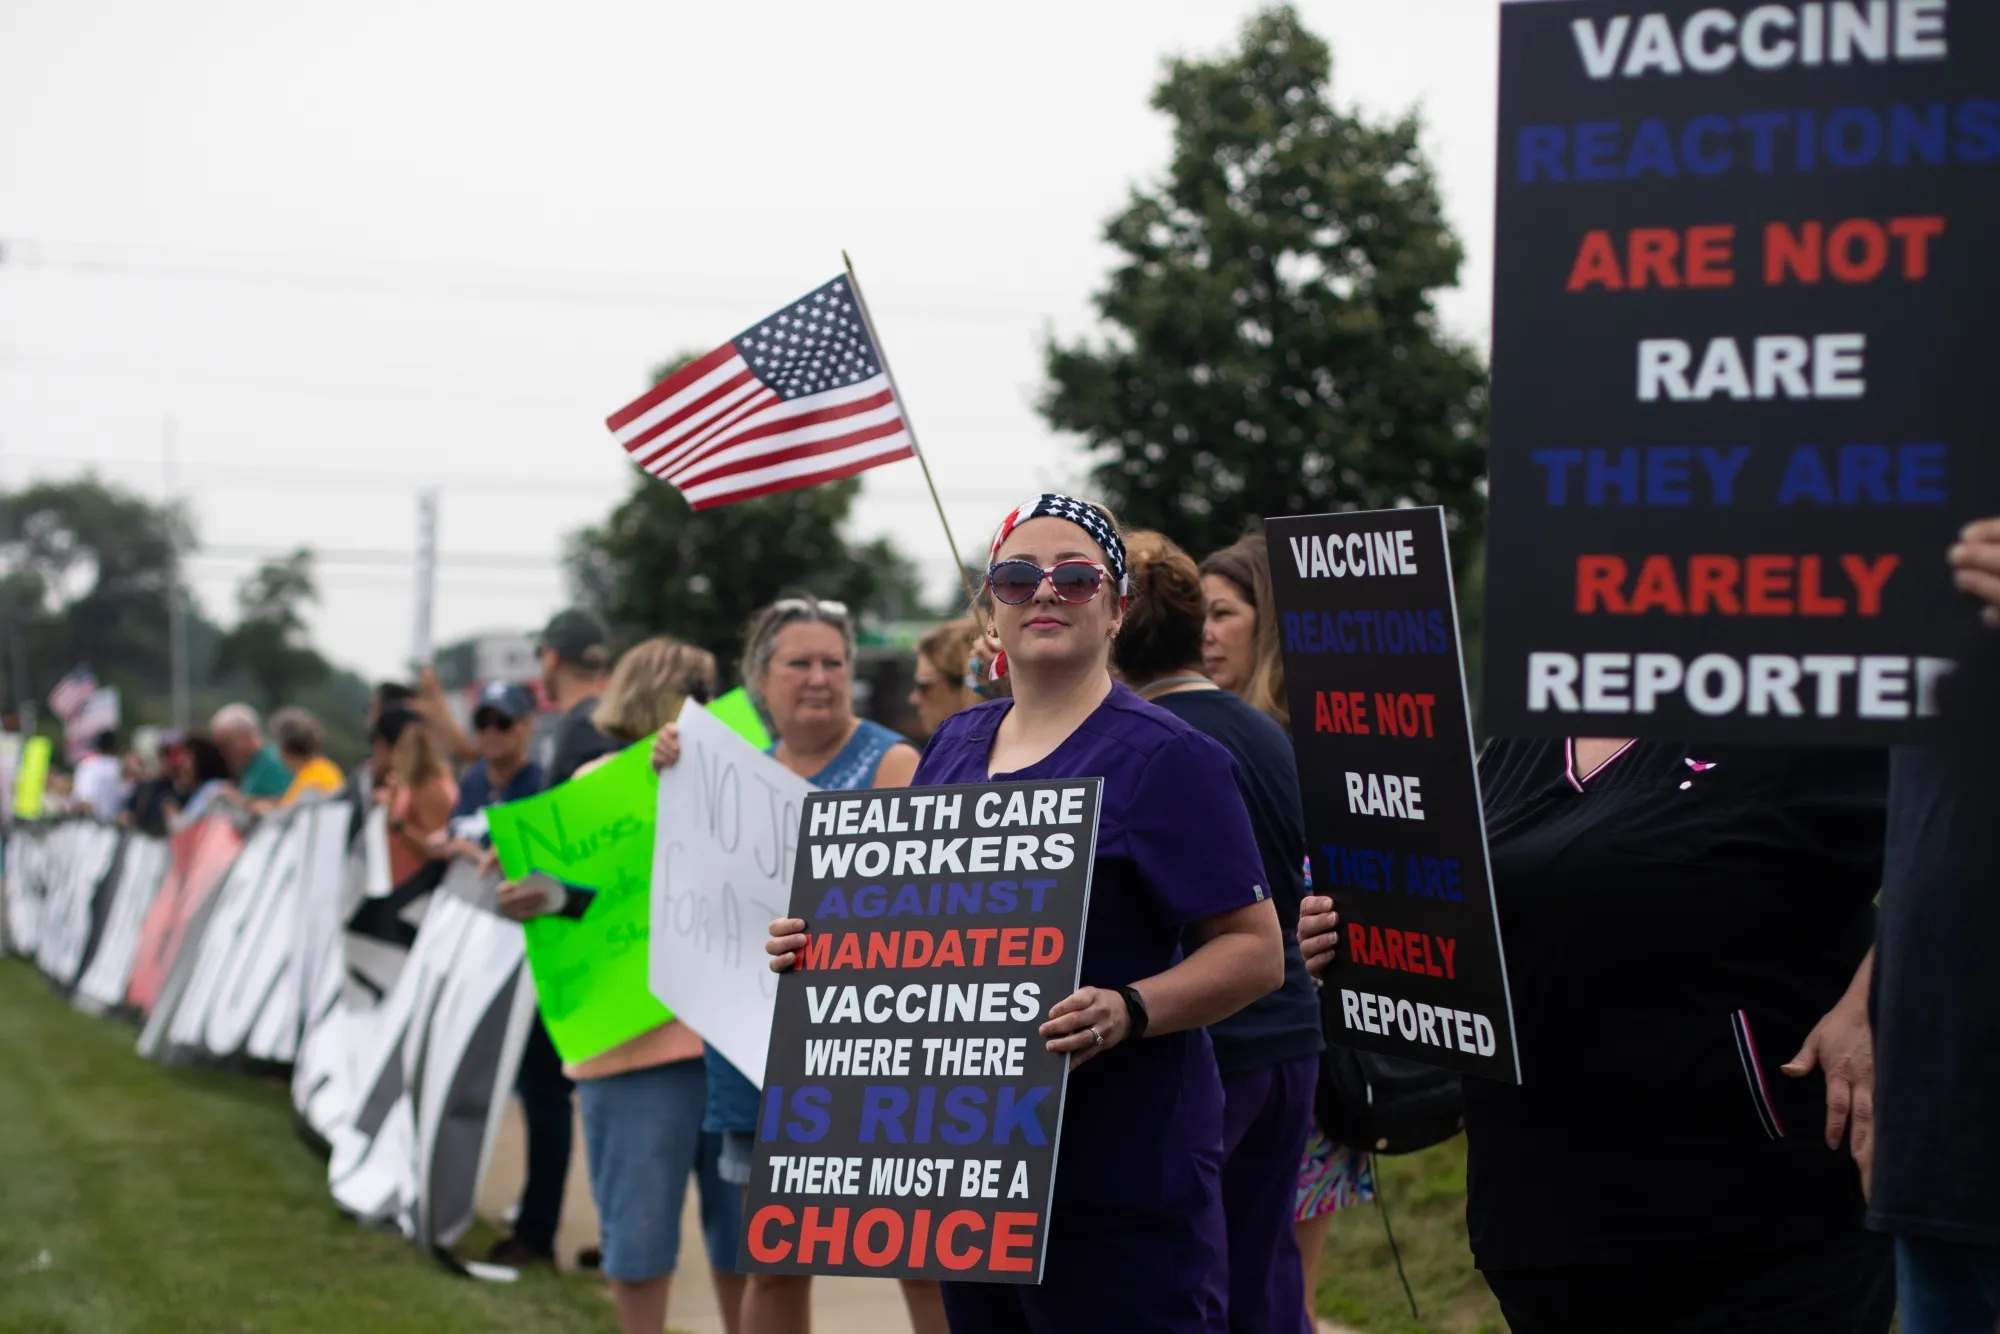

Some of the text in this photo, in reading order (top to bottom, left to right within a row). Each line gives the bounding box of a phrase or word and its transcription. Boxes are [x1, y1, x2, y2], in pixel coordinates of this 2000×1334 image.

[1572, 0, 1946, 78] VACCINE
[1516, 98, 2000, 184] REACTIONS
[1568, 218, 1943, 290] ARE NOT
[1639, 335, 1863, 399] RARE
[1531, 443, 1948, 506] THEY ARE
[1290, 531, 1417, 578] VACCINE
[1577, 555, 1898, 615] RARELY
[1283, 609, 1447, 655] REACTIONS
[1316, 691, 1434, 737] ARE NOT
[695, 739, 799, 885] NO JA
[810, 788, 1085, 836] HEALTH CARE
[1346, 772, 1424, 819] RARE
[810, 833, 1075, 879] WORKERS
[1321, 844, 1464, 902] THEY ARE
[814, 878, 1058, 920] AGAINST
[794, 927, 1064, 970] MANDATED
[1348, 923, 1455, 978] RARELY
[806, 982, 1040, 1023] VACCINES
[1342, 989, 1495, 1056] REPORTED
[805, 1038, 1026, 1075] WHERE THERE
[761, 1084, 1053, 1146] IS RISK
[769, 1156, 1028, 1198] THERE MUST BE A
[748, 1205, 1038, 1272] CHOICE
